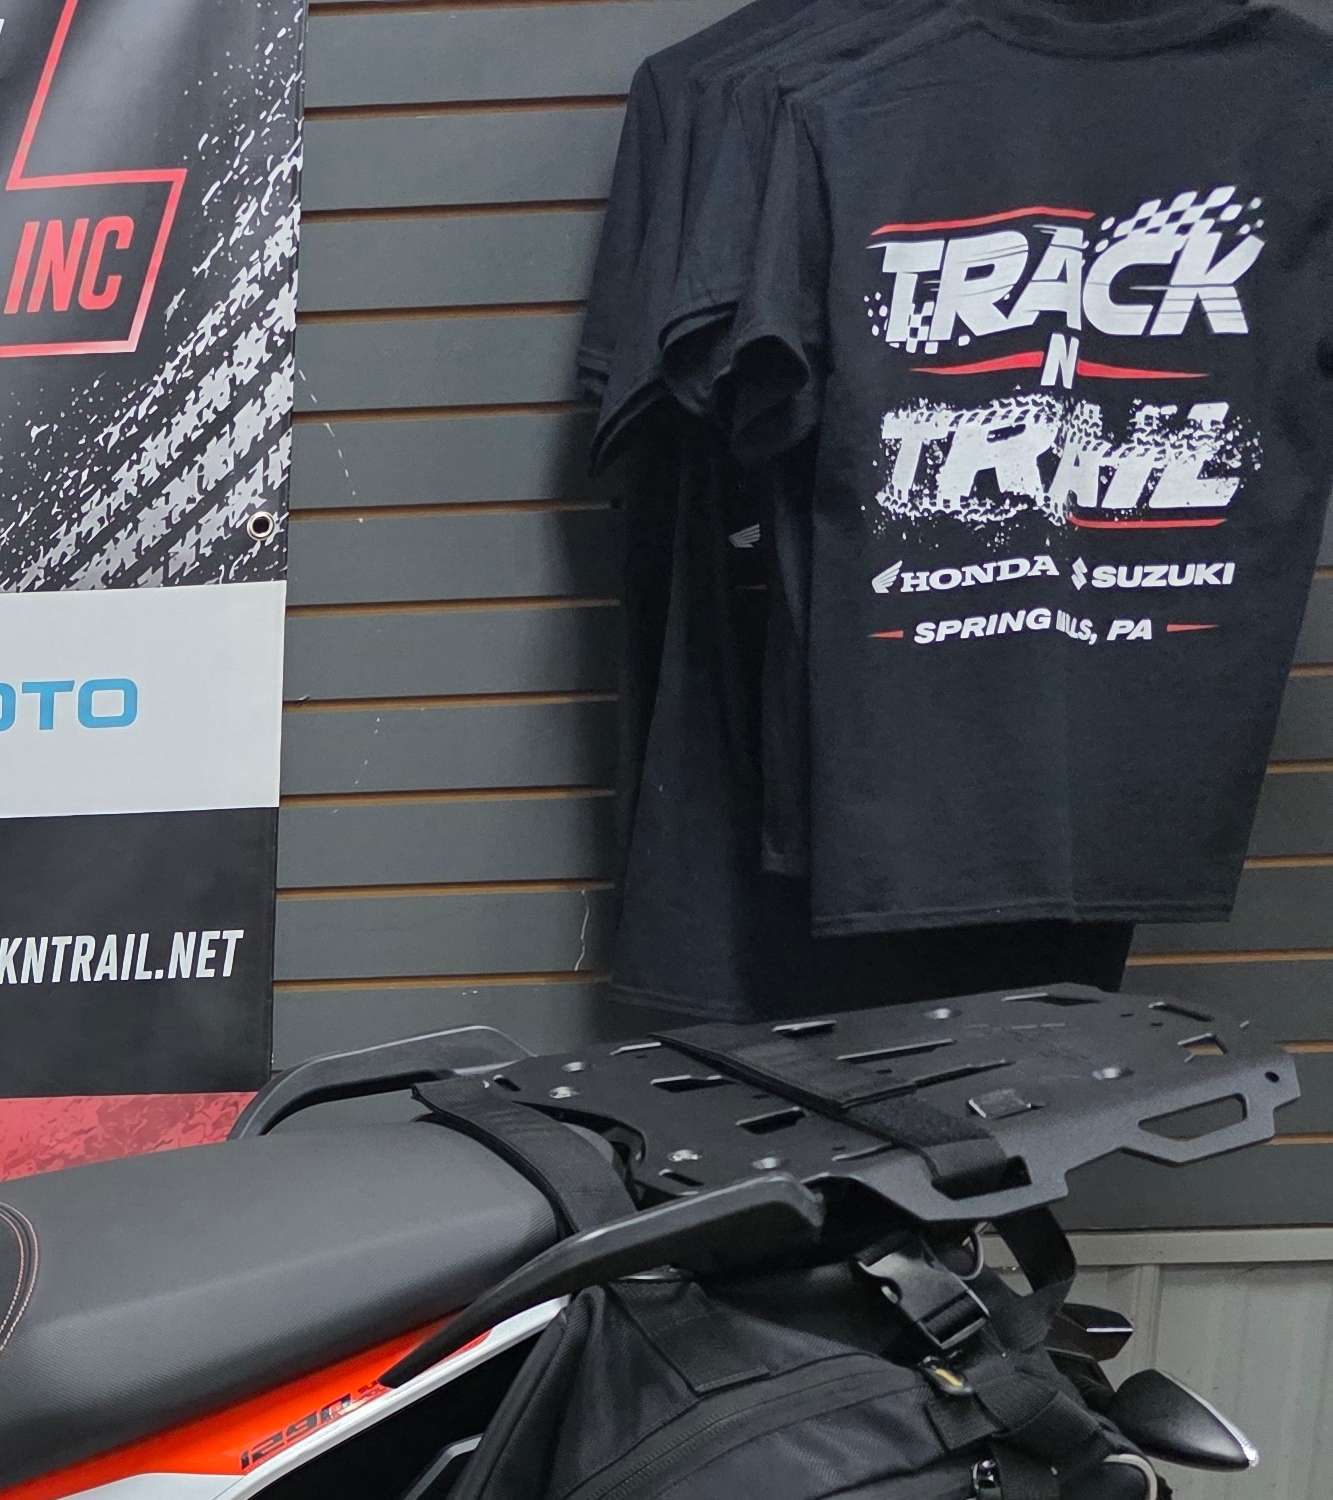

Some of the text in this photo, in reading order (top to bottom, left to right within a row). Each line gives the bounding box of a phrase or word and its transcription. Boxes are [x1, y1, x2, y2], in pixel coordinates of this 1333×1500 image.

[4, 215, 133, 315] INC
[867, 219, 1265, 338] TRACK
[1041, 333, 1080, 389] N
[879, 400, 1241, 512] TRAIL
[900, 555, 1235, 593] HONDA SUZUKI
[914, 608, 1052, 644] SPRING
[1106, 618, 1153, 642] PA
